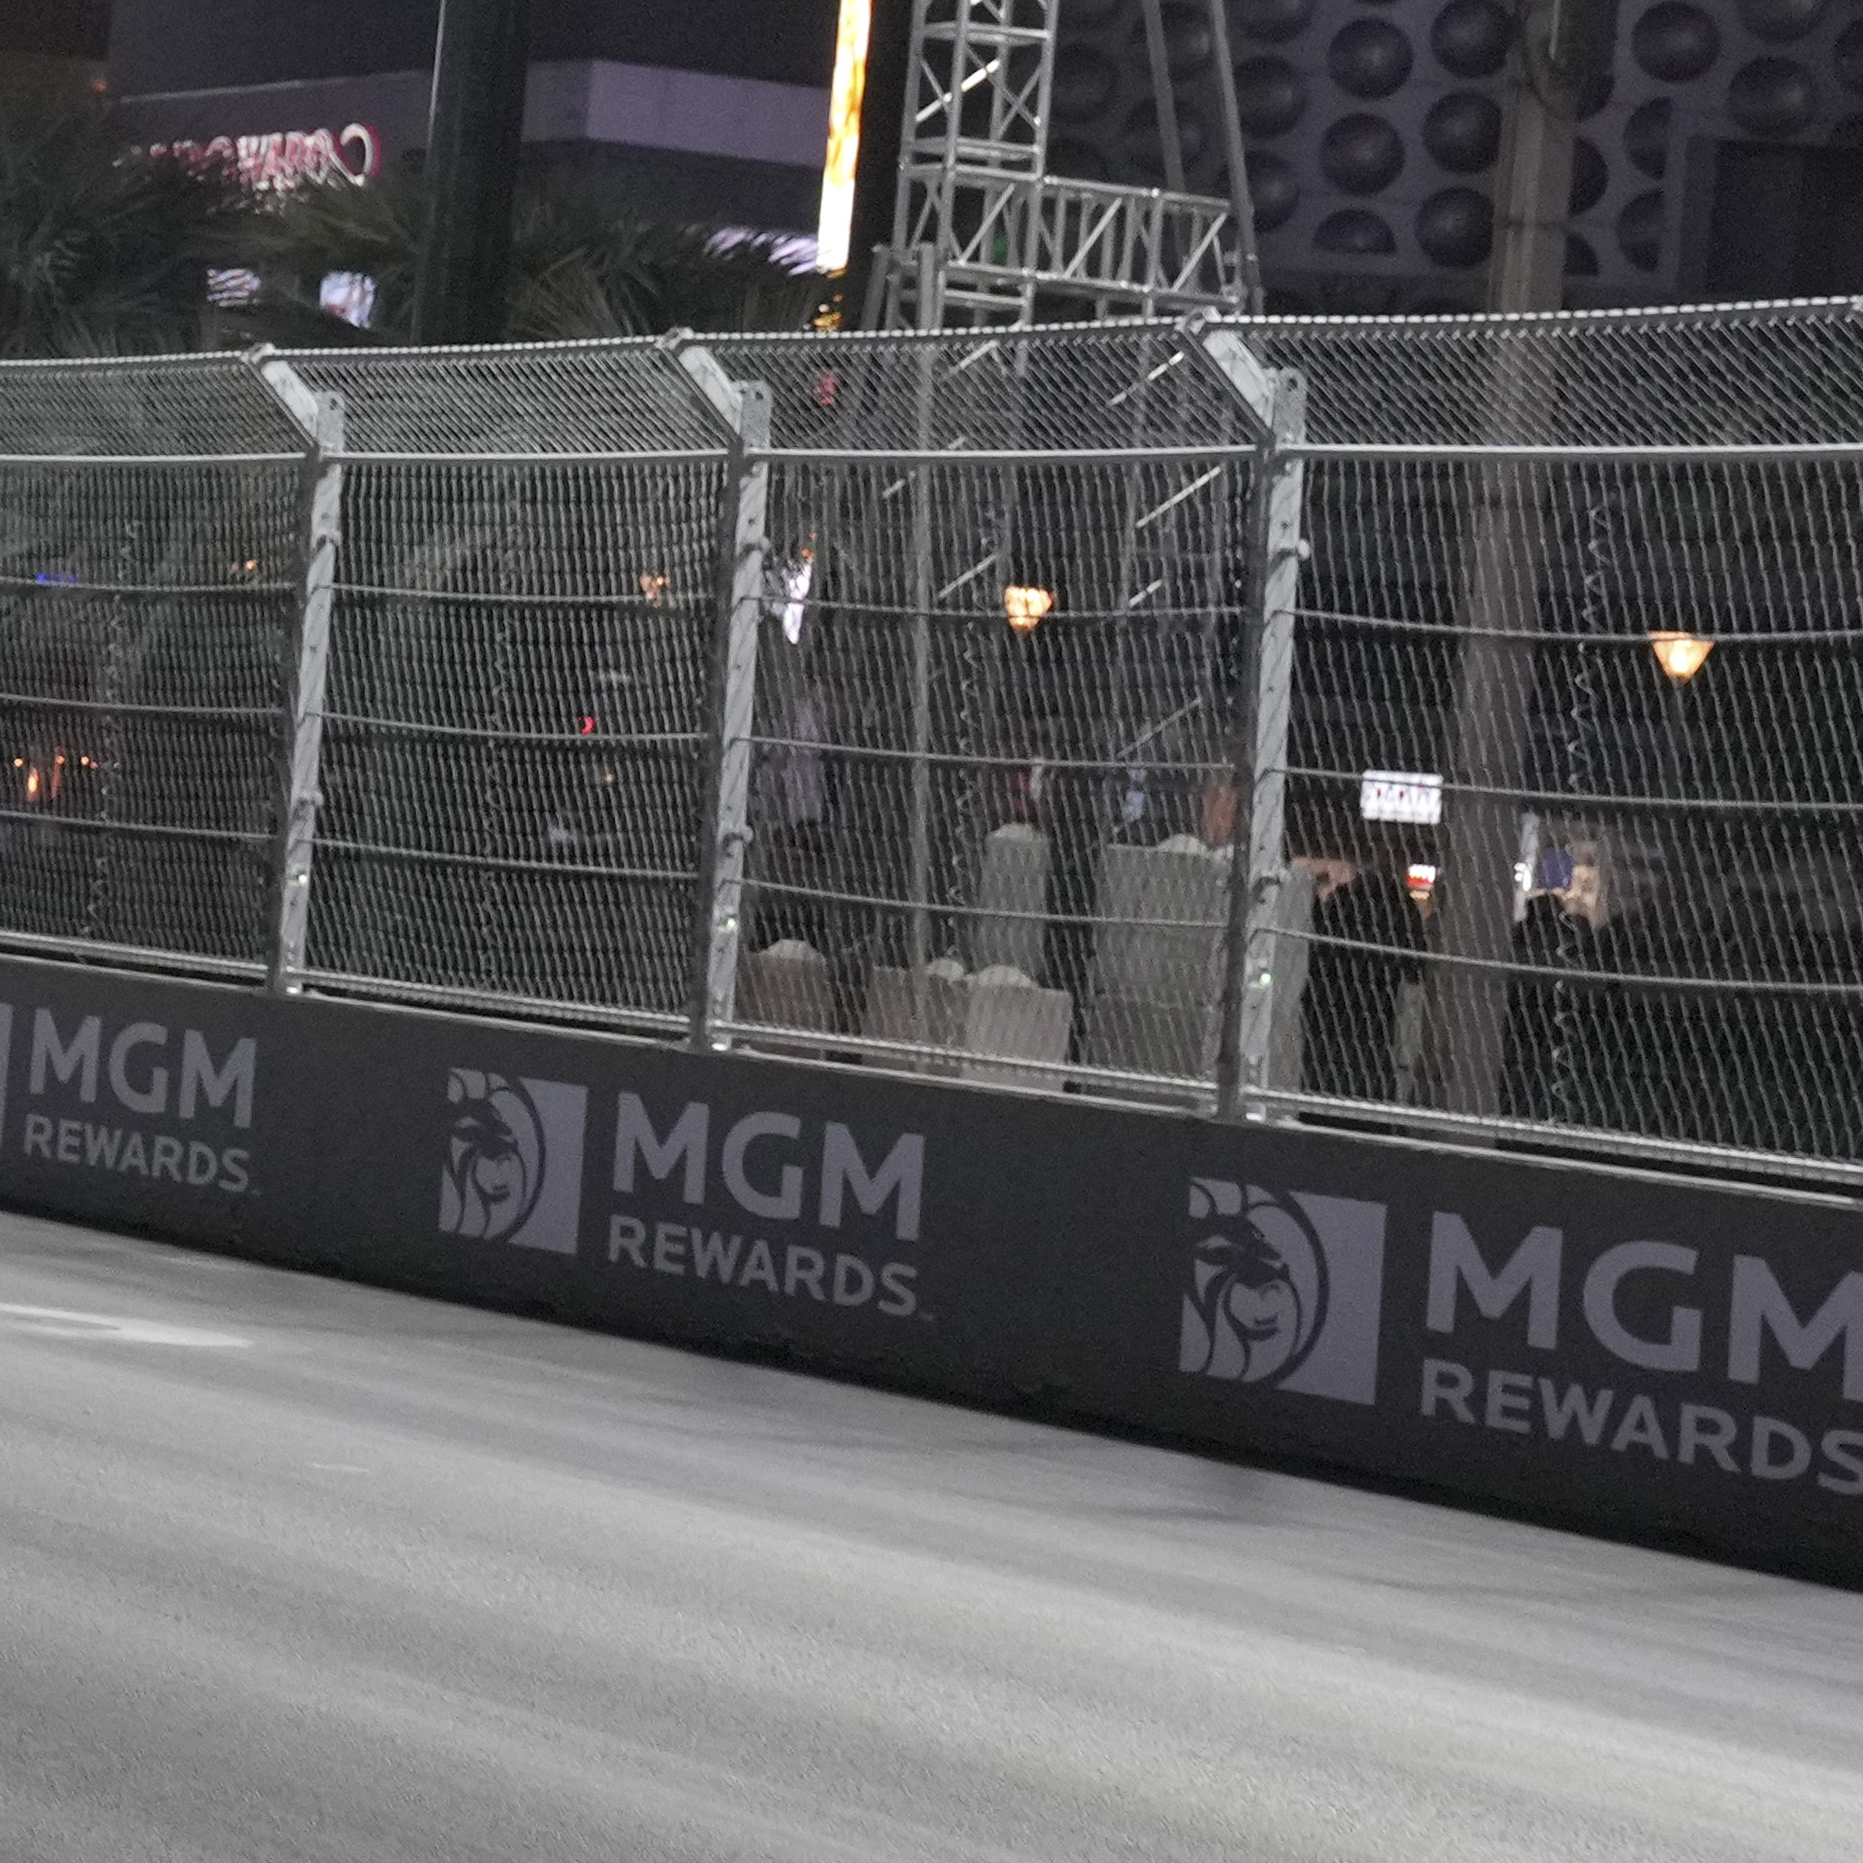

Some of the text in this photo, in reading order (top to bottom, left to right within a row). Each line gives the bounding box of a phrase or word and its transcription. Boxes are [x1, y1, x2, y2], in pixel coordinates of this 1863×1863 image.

[28, 1007, 258, 1129] MGM
[23, 1112, 253, 1194] REWARDS
[612, 1091, 926, 1242] MGM
[608, 1214, 921, 1317] REWARDS
[1425, 1210, 1863, 1405] MGM
[1420, 1357, 1863, 1497] REWARDS
